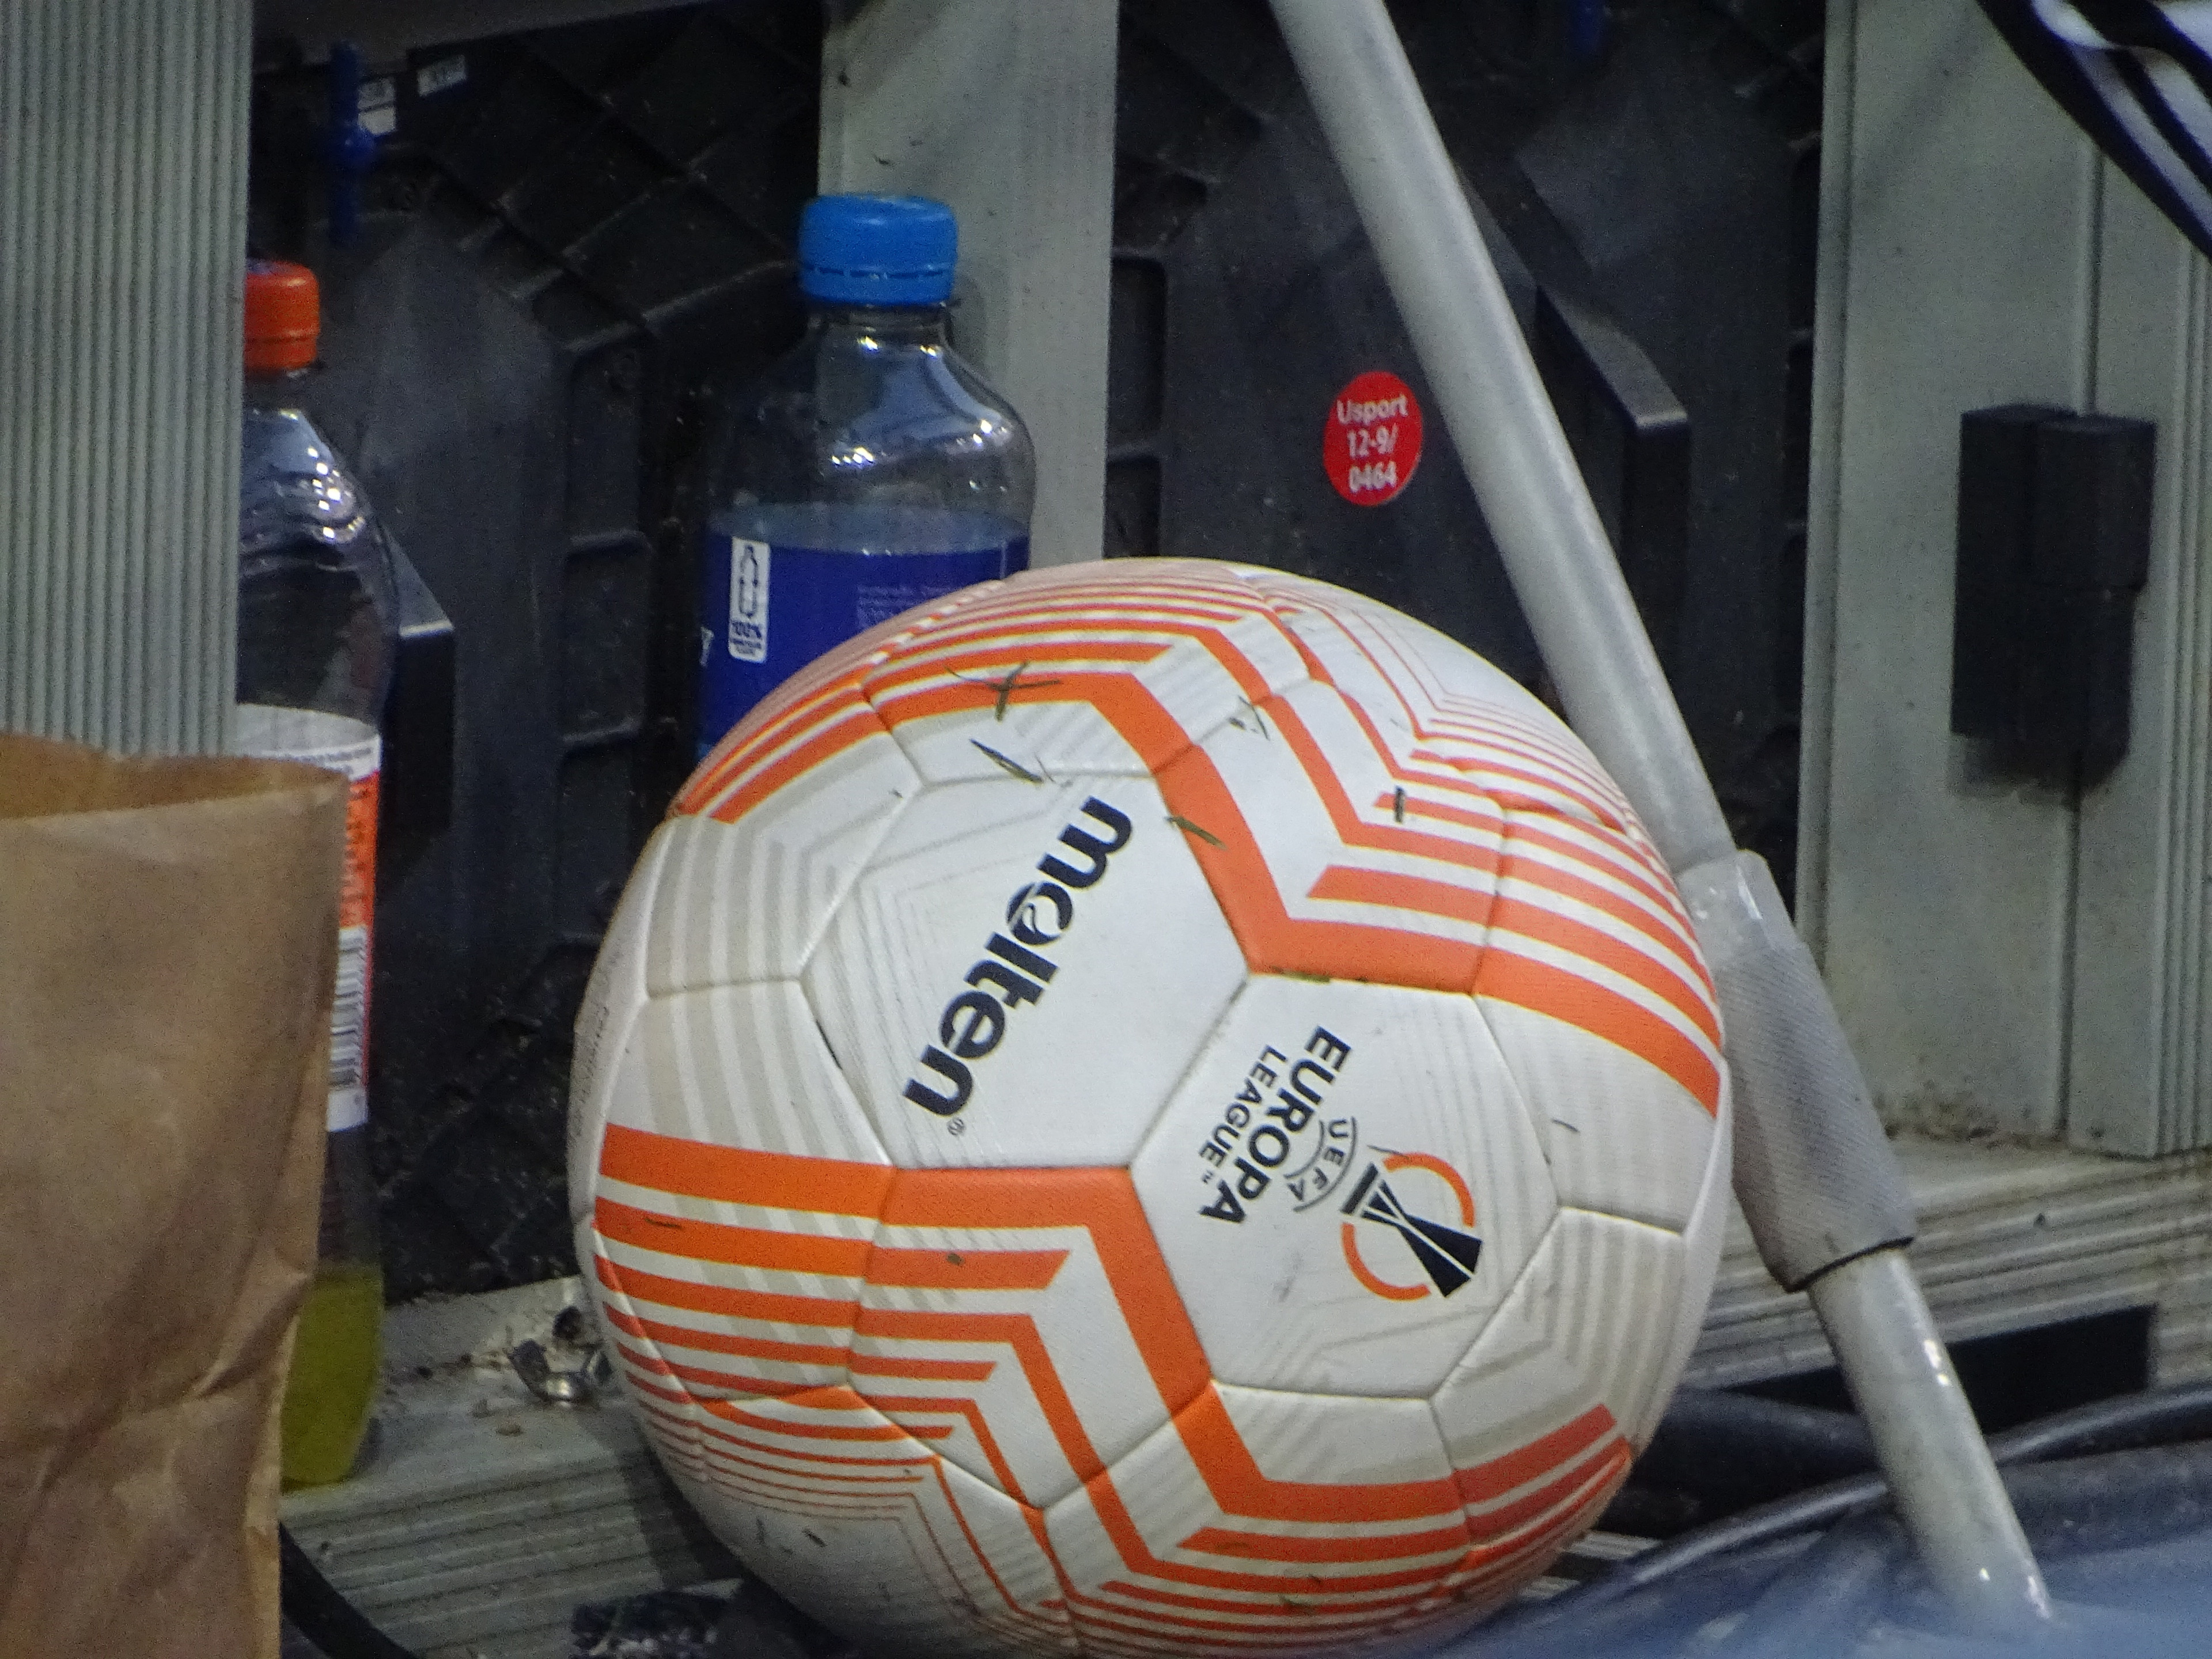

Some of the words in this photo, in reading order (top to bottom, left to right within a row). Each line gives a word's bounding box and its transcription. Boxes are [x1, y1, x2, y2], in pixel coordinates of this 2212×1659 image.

[1336, 392, 1408, 425] Usport
[902, 795, 1132, 1116] molten
[1198, 1025, 1353, 1224] EUROPA
[1199, 1044, 1287, 1168] LEAGUE
[1286, 1118, 1350, 1202] UEFA
